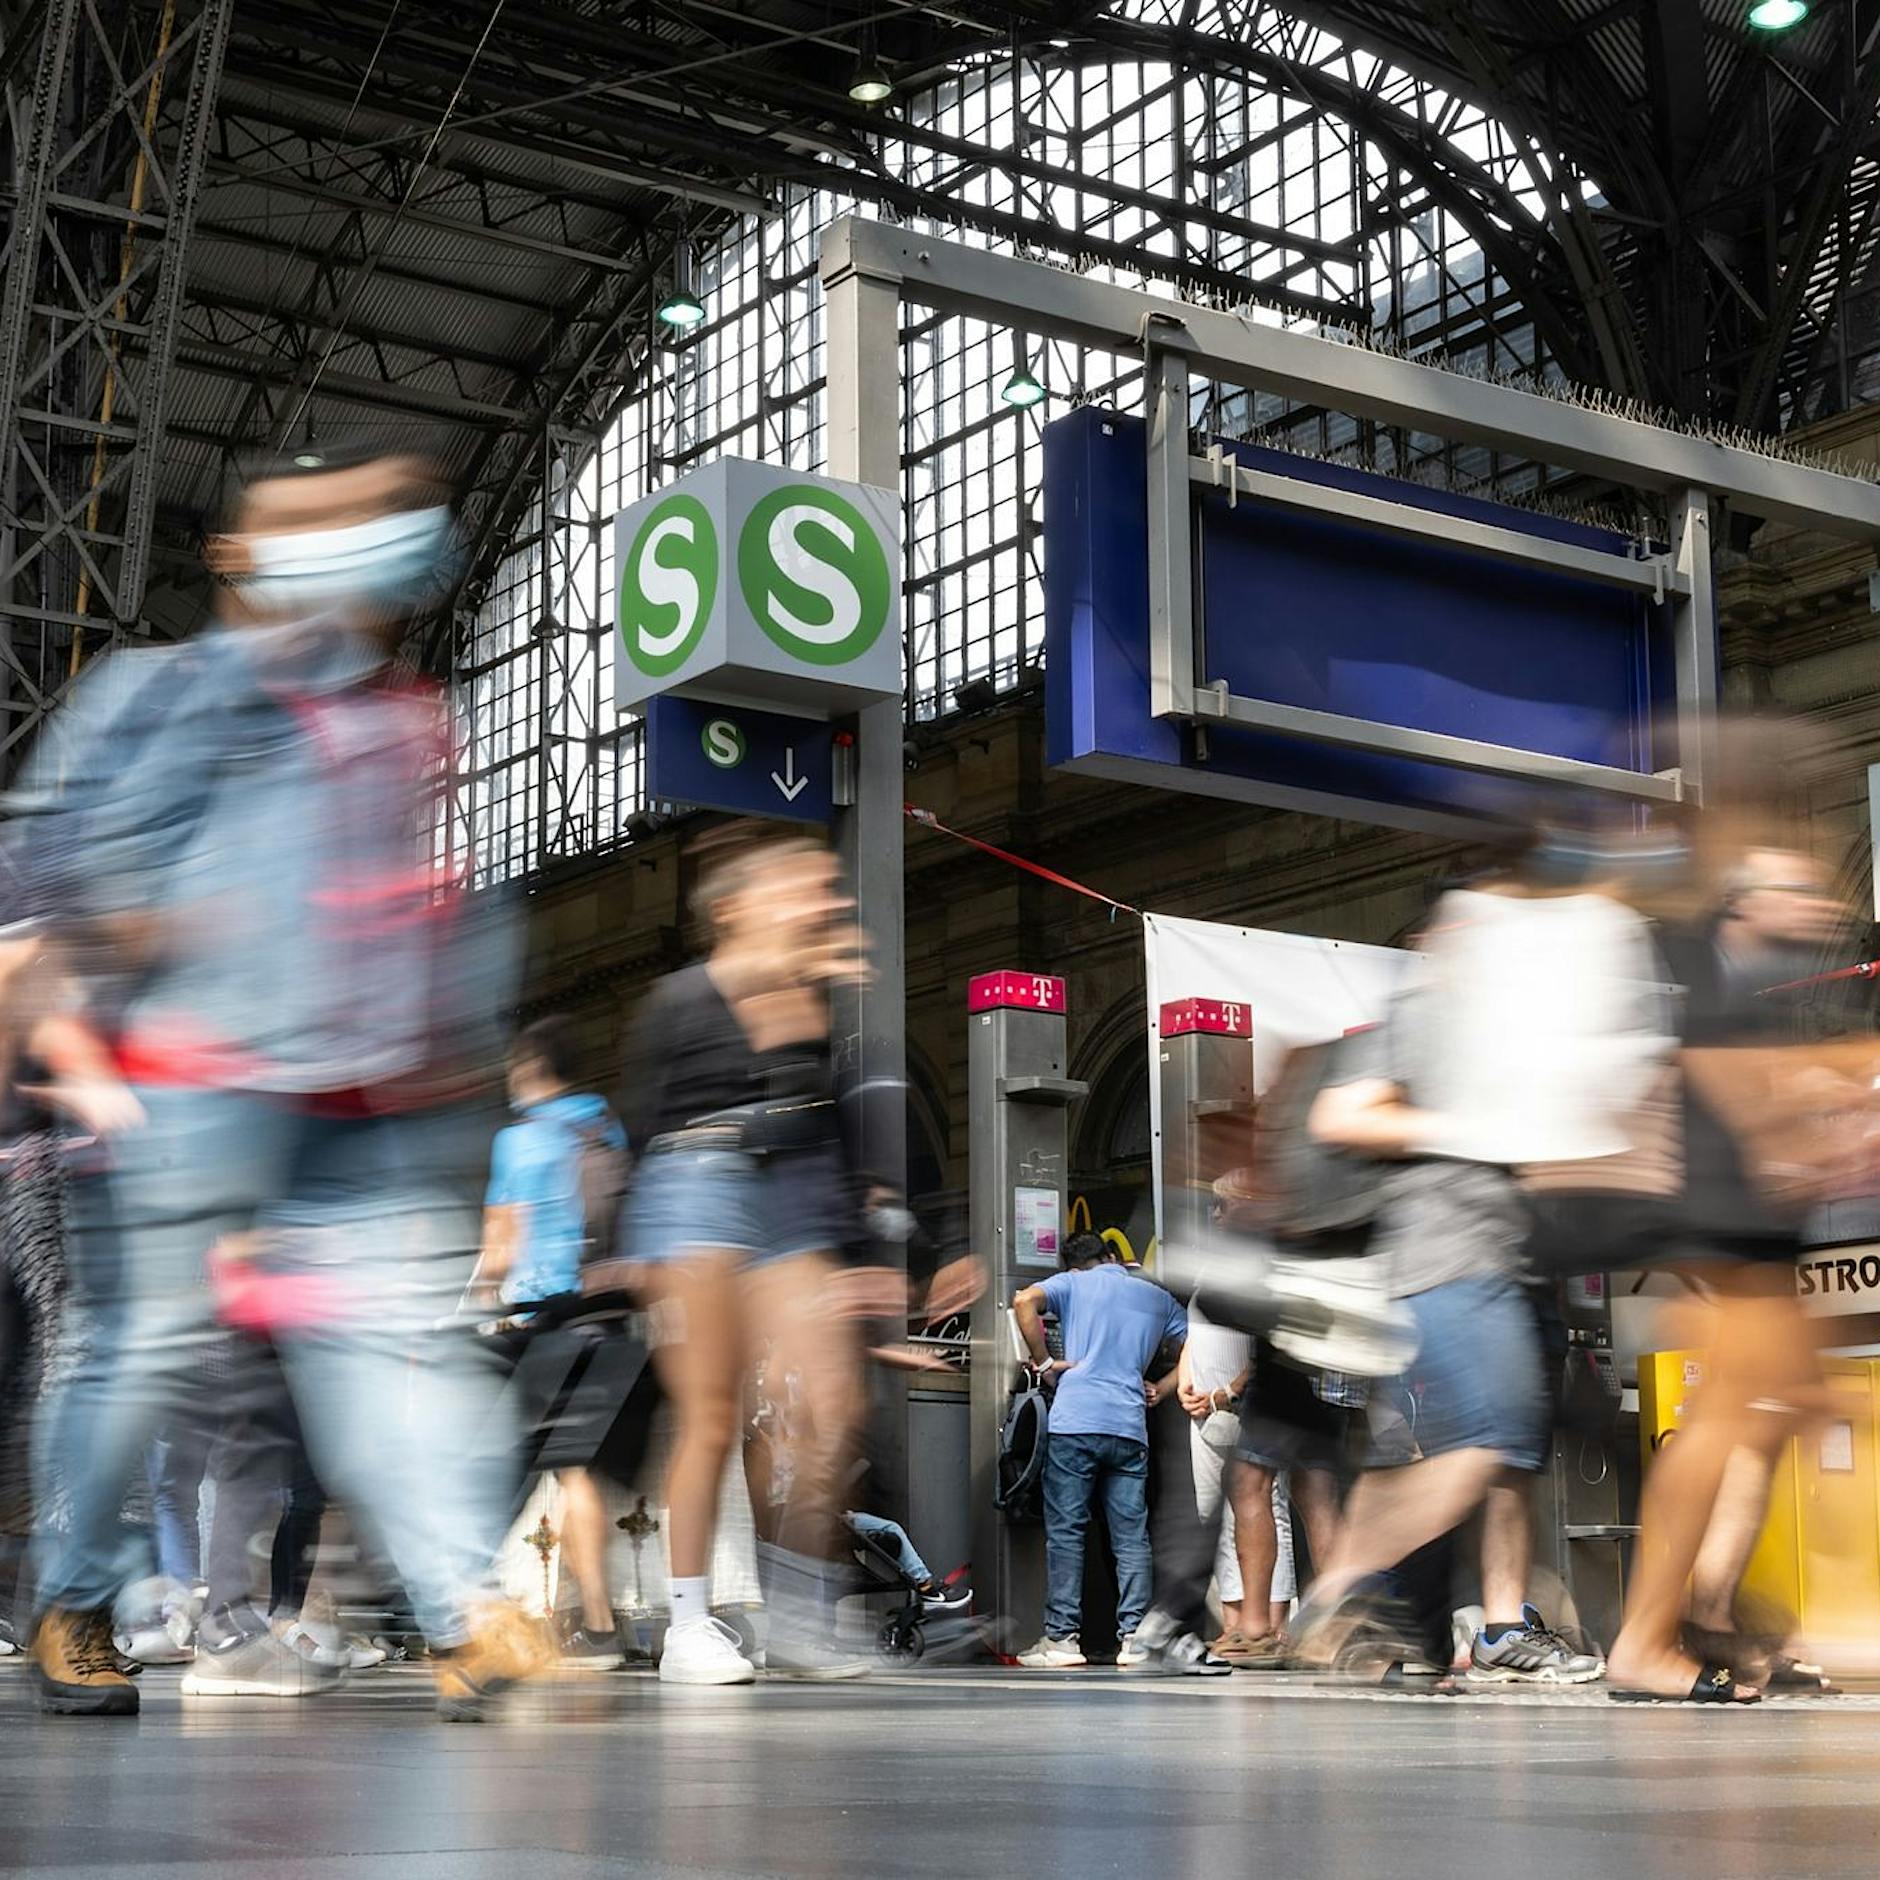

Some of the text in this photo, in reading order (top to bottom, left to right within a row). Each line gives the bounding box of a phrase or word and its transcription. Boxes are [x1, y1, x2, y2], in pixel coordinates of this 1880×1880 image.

[638, 516, 699, 657] S
[768, 504, 861, 645] S
[708, 720, 739, 765] S
[1033, 977, 1052, 1007] T
[1222, 1003, 1241, 1031] T
[1794, 1255, 1880, 1296] STRO
